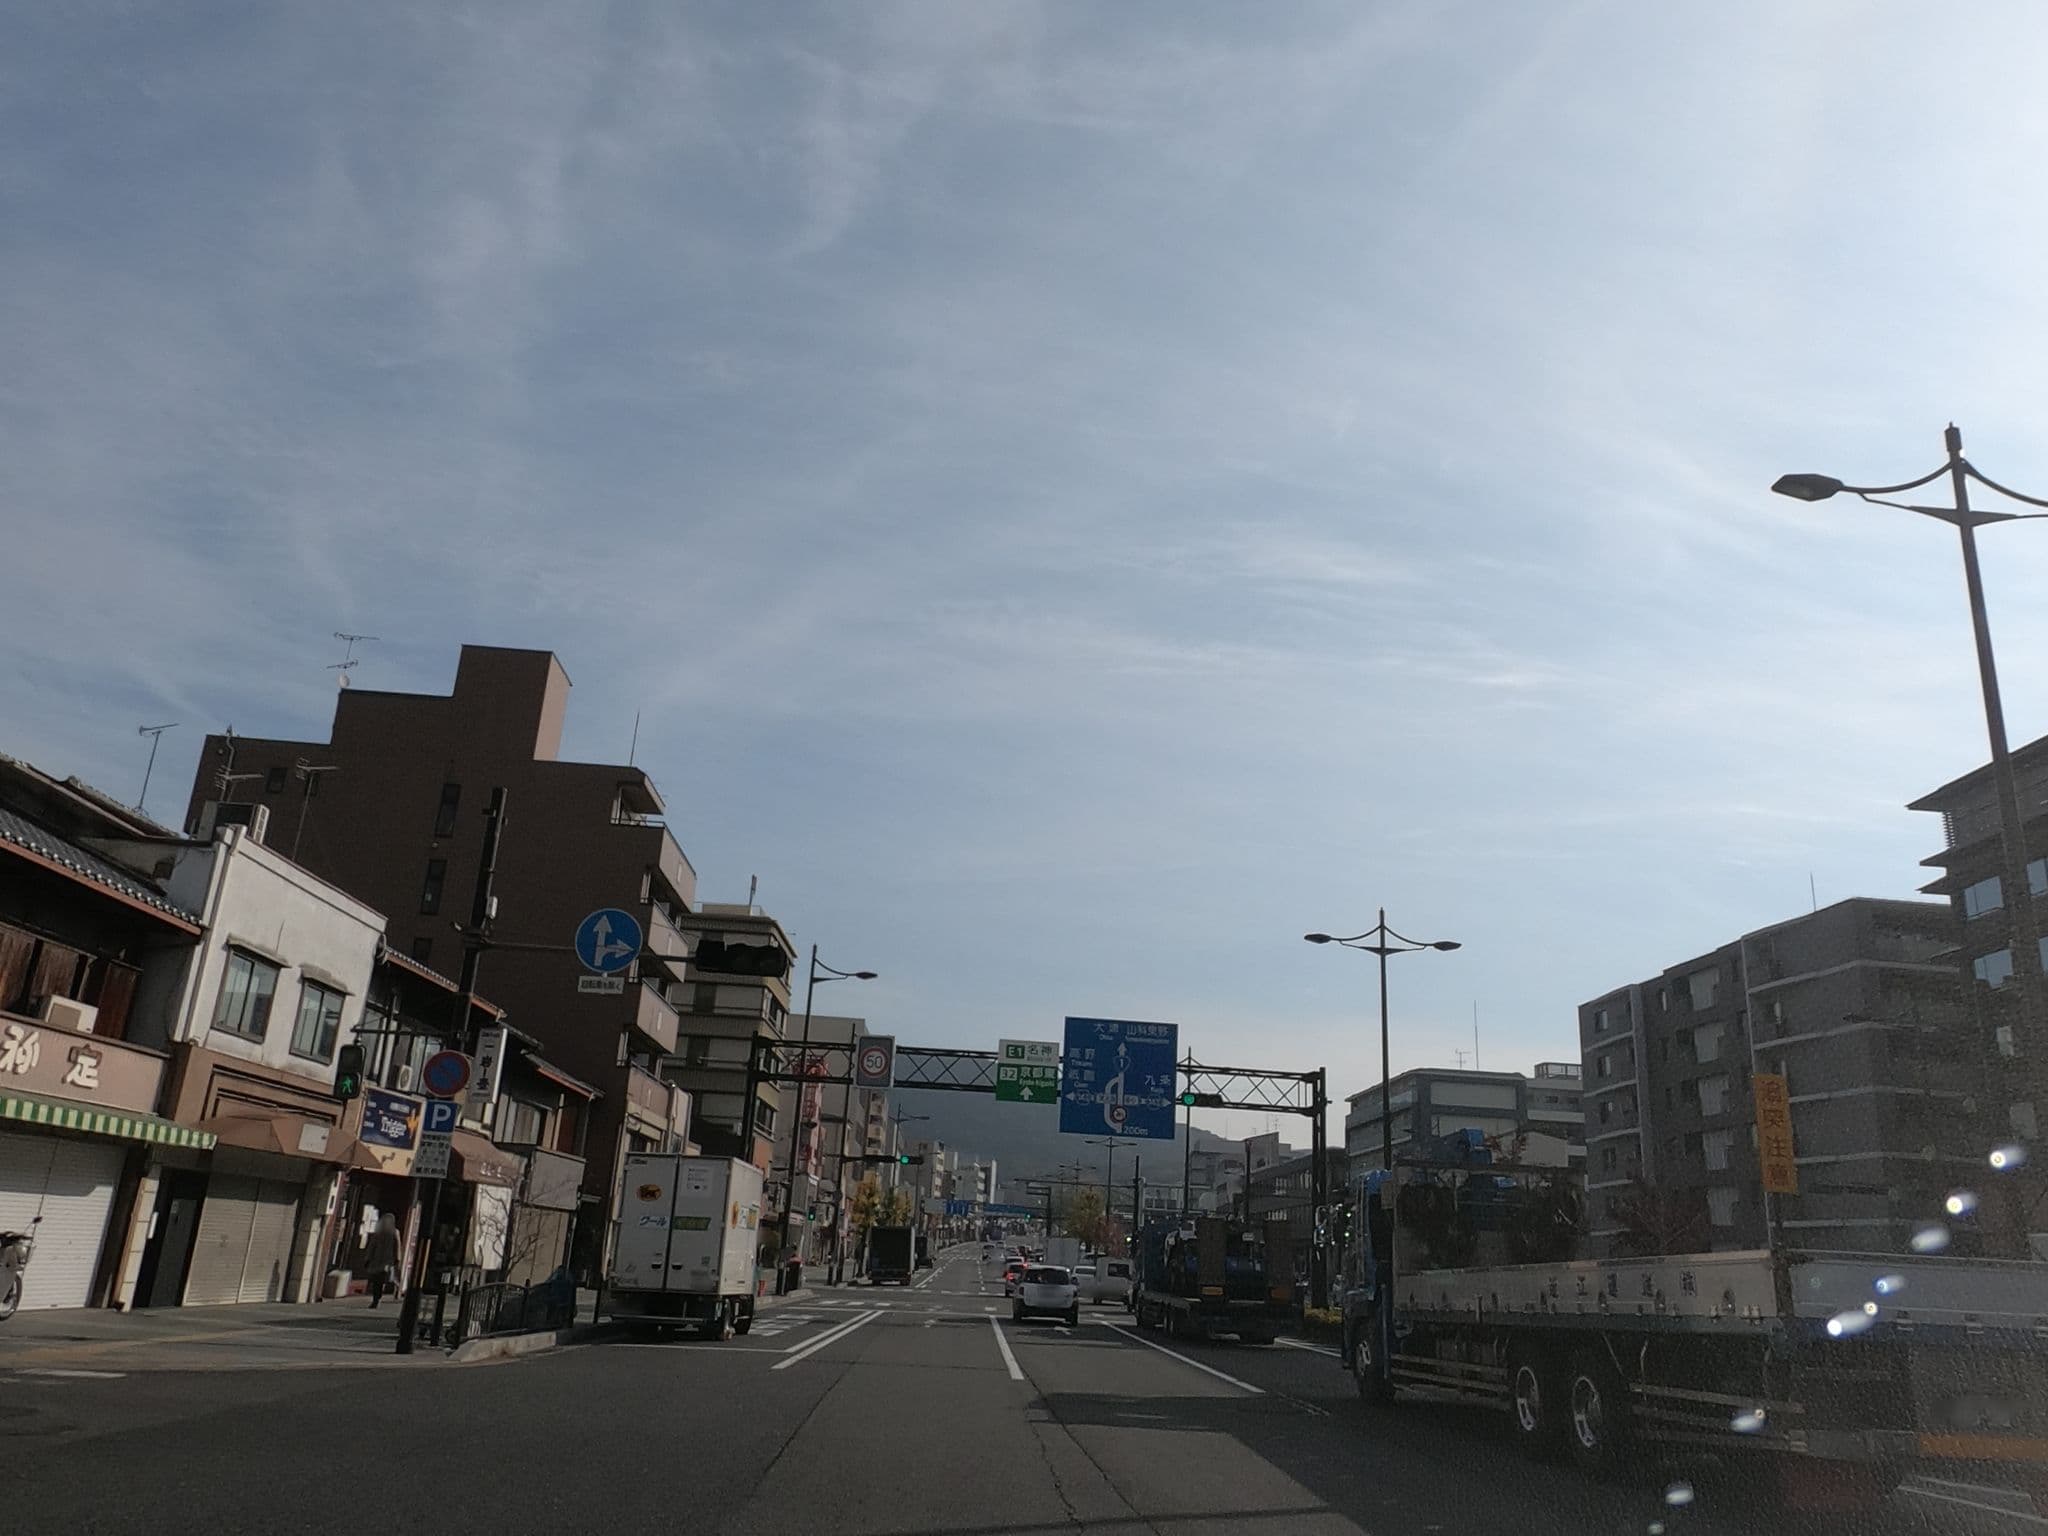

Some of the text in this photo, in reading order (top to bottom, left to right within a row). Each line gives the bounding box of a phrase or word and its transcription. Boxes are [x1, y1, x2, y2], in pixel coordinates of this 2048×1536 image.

[1008, 1044, 1052, 1057] E1 名神
[866, 1055, 883, 1069] 50
[1002, 1068, 1016, 1079] 32
[430, 1103, 452, 1129] P
[1123, 1125, 1149, 1136] 200m
